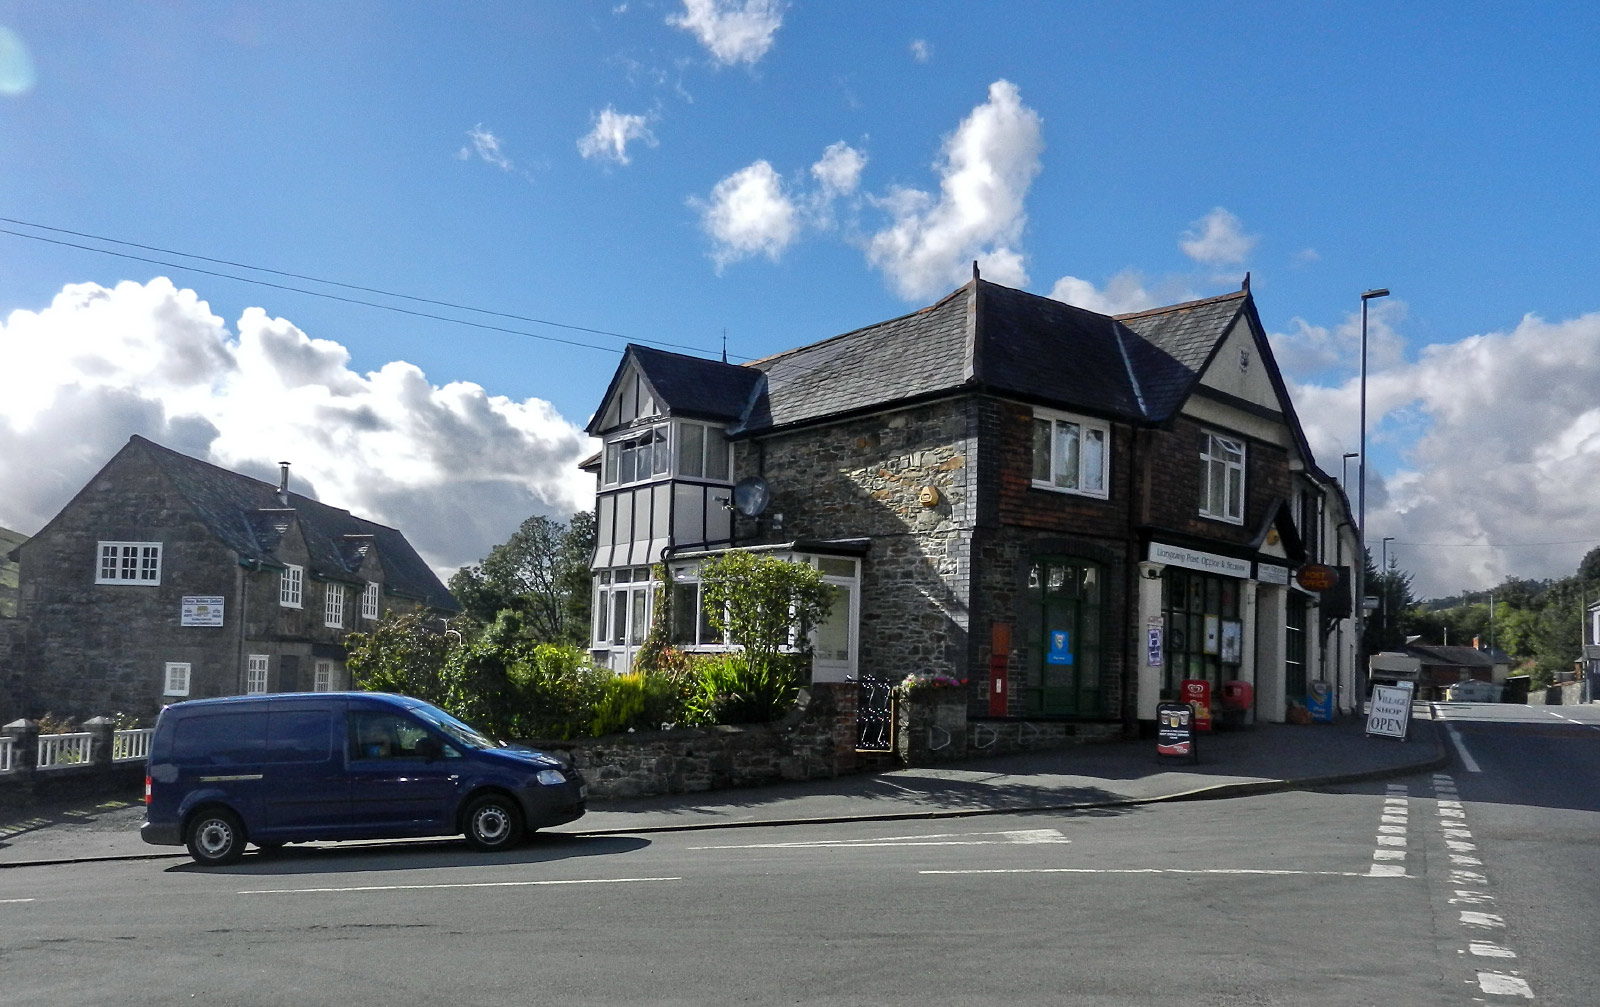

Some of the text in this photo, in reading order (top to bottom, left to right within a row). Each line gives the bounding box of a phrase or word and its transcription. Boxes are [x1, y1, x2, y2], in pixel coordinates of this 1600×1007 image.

[1186, 553, 1200, 564] Post
[1201, 556, 1221, 568] Office
[1305, 571, 1326, 579] POST
[1301, 579, 1329, 588] OFFICE
[1377, 689, 1406, 706] VILLAGE
[1375, 706, 1402, 716] SHOP
[1371, 717, 1402, 732] OPEN
